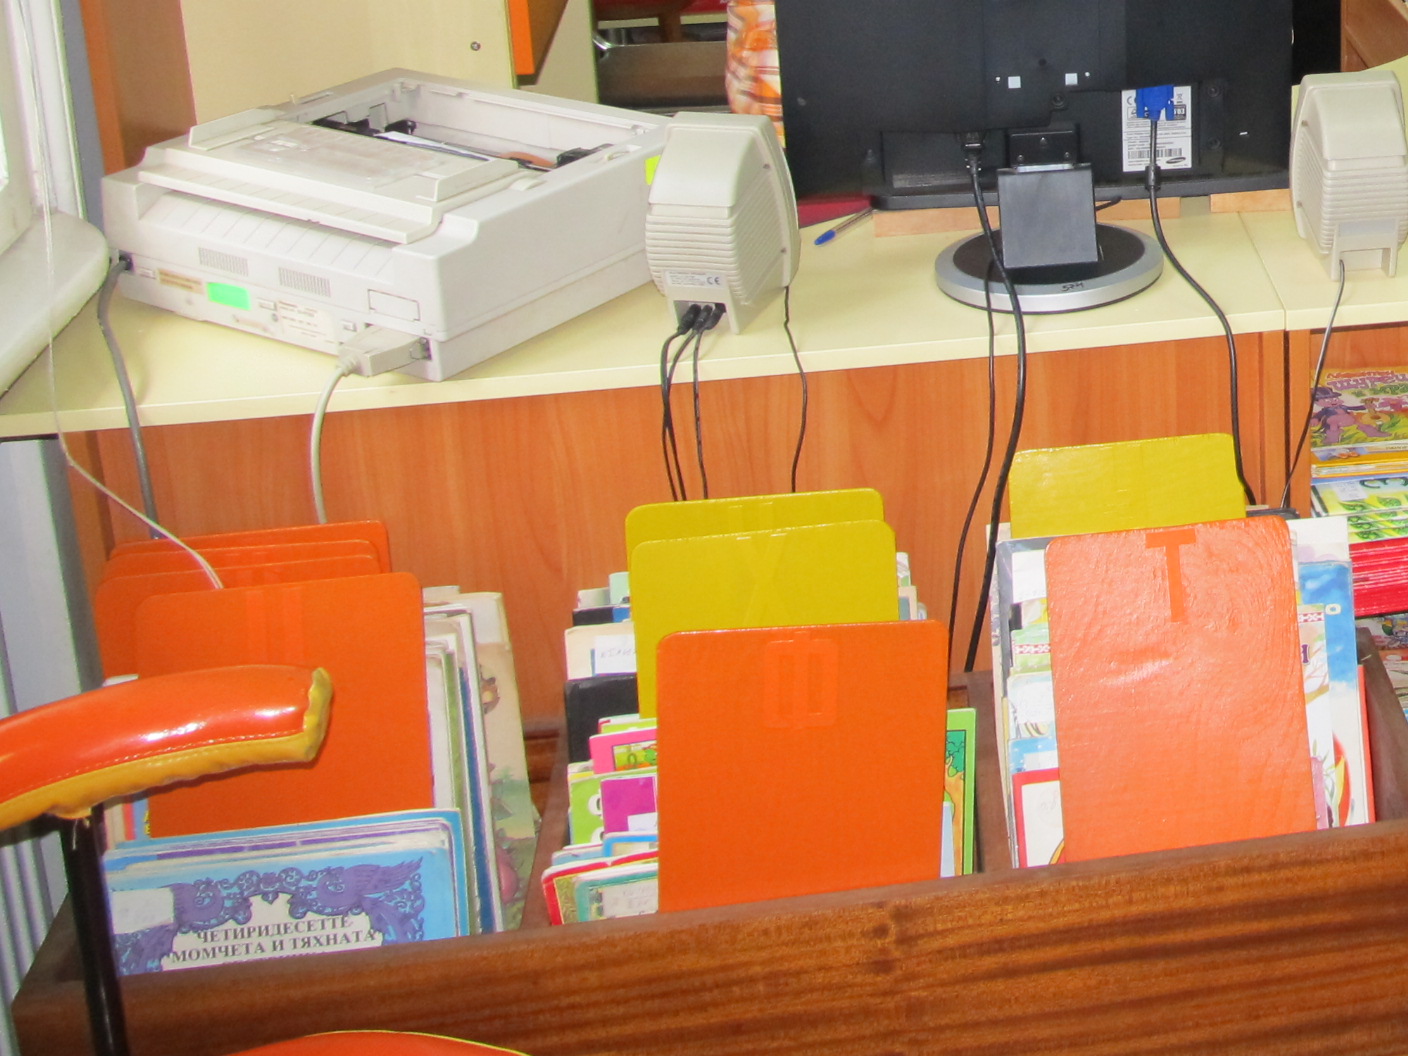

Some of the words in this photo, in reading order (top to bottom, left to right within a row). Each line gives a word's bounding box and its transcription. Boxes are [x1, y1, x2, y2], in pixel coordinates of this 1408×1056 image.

[1145, 527, 1197, 623] Т
[171, 941, 265, 963] МОМЧЕТА
[271, 939, 285, 952] И
[291, 928, 378, 950] ТЯХНАТА
[197, 916, 353, 944] ЧЕТИРИДЕСЕТТЕ
